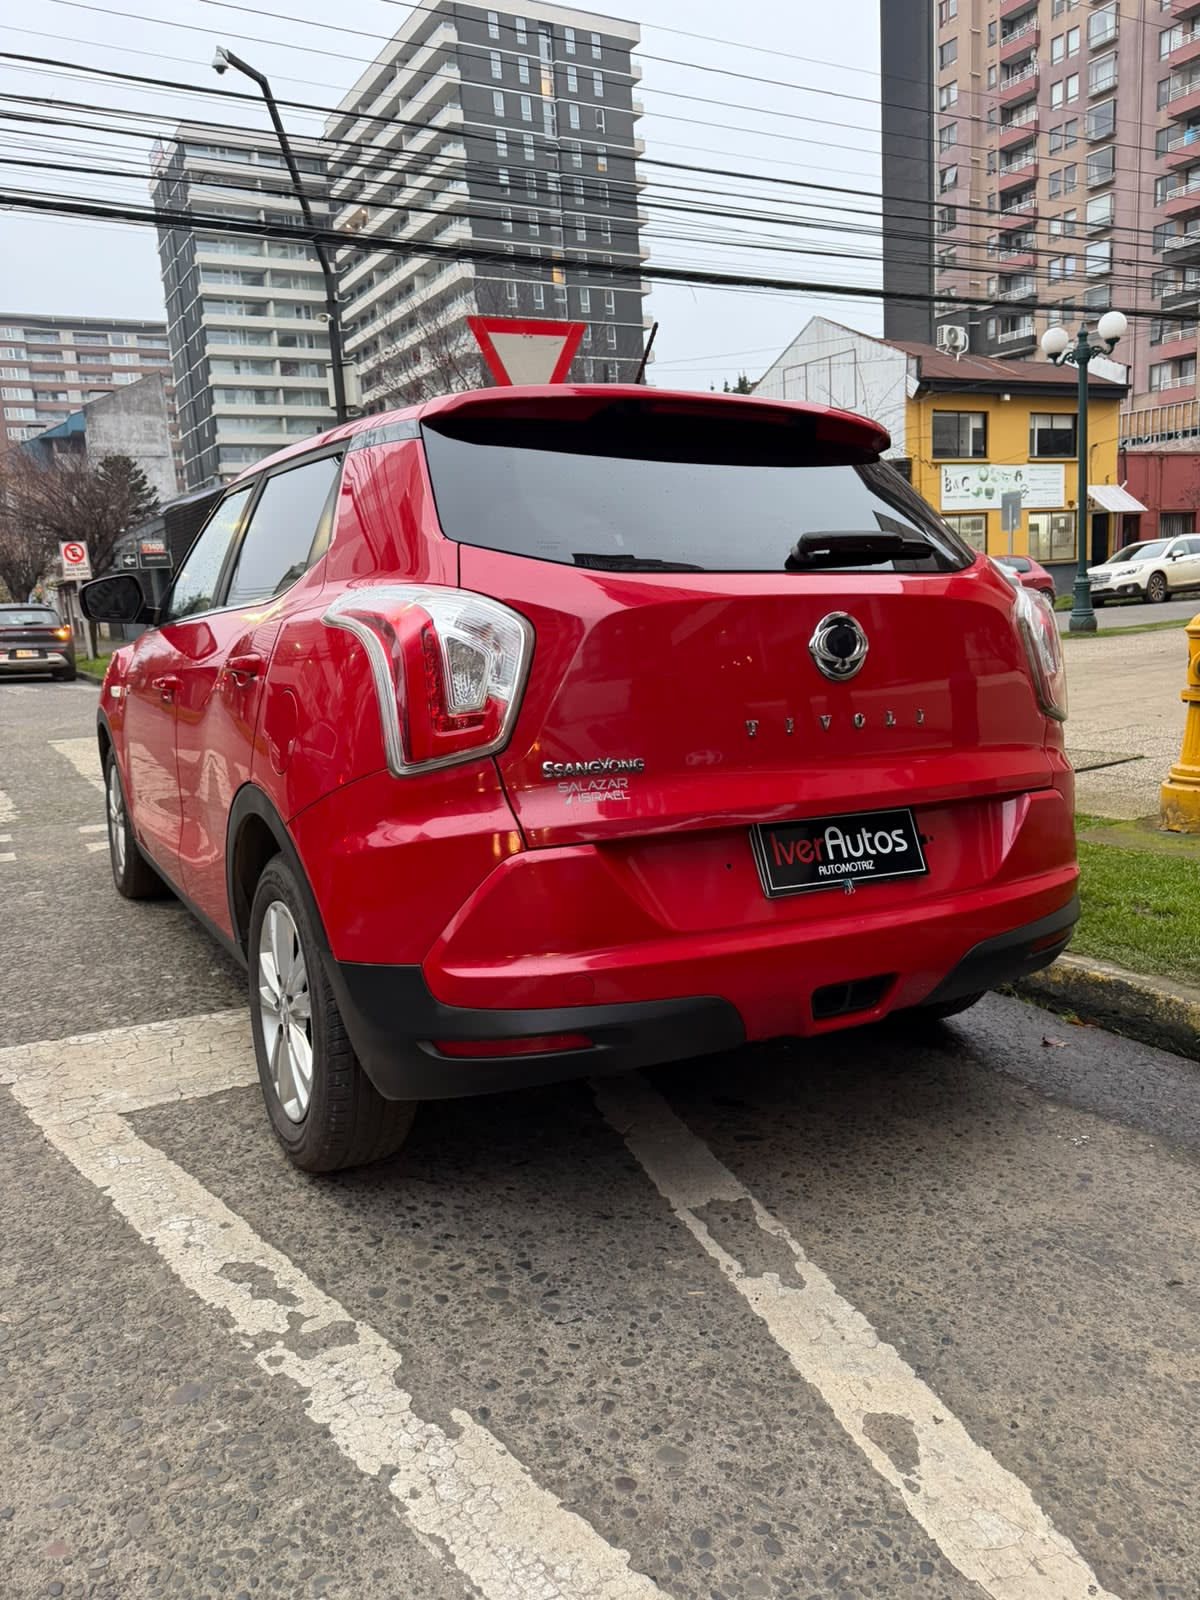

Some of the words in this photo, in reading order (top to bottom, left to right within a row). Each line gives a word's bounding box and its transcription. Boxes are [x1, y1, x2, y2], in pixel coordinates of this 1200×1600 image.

[746, 709, 925, 736] TIVOLI
[558, 778, 629, 793] SALAZAR
[577, 790, 631, 802] ISRAEL
[770, 826, 908, 866] IverAutos
[818, 859, 875, 876] AUTOMOTRIZ
